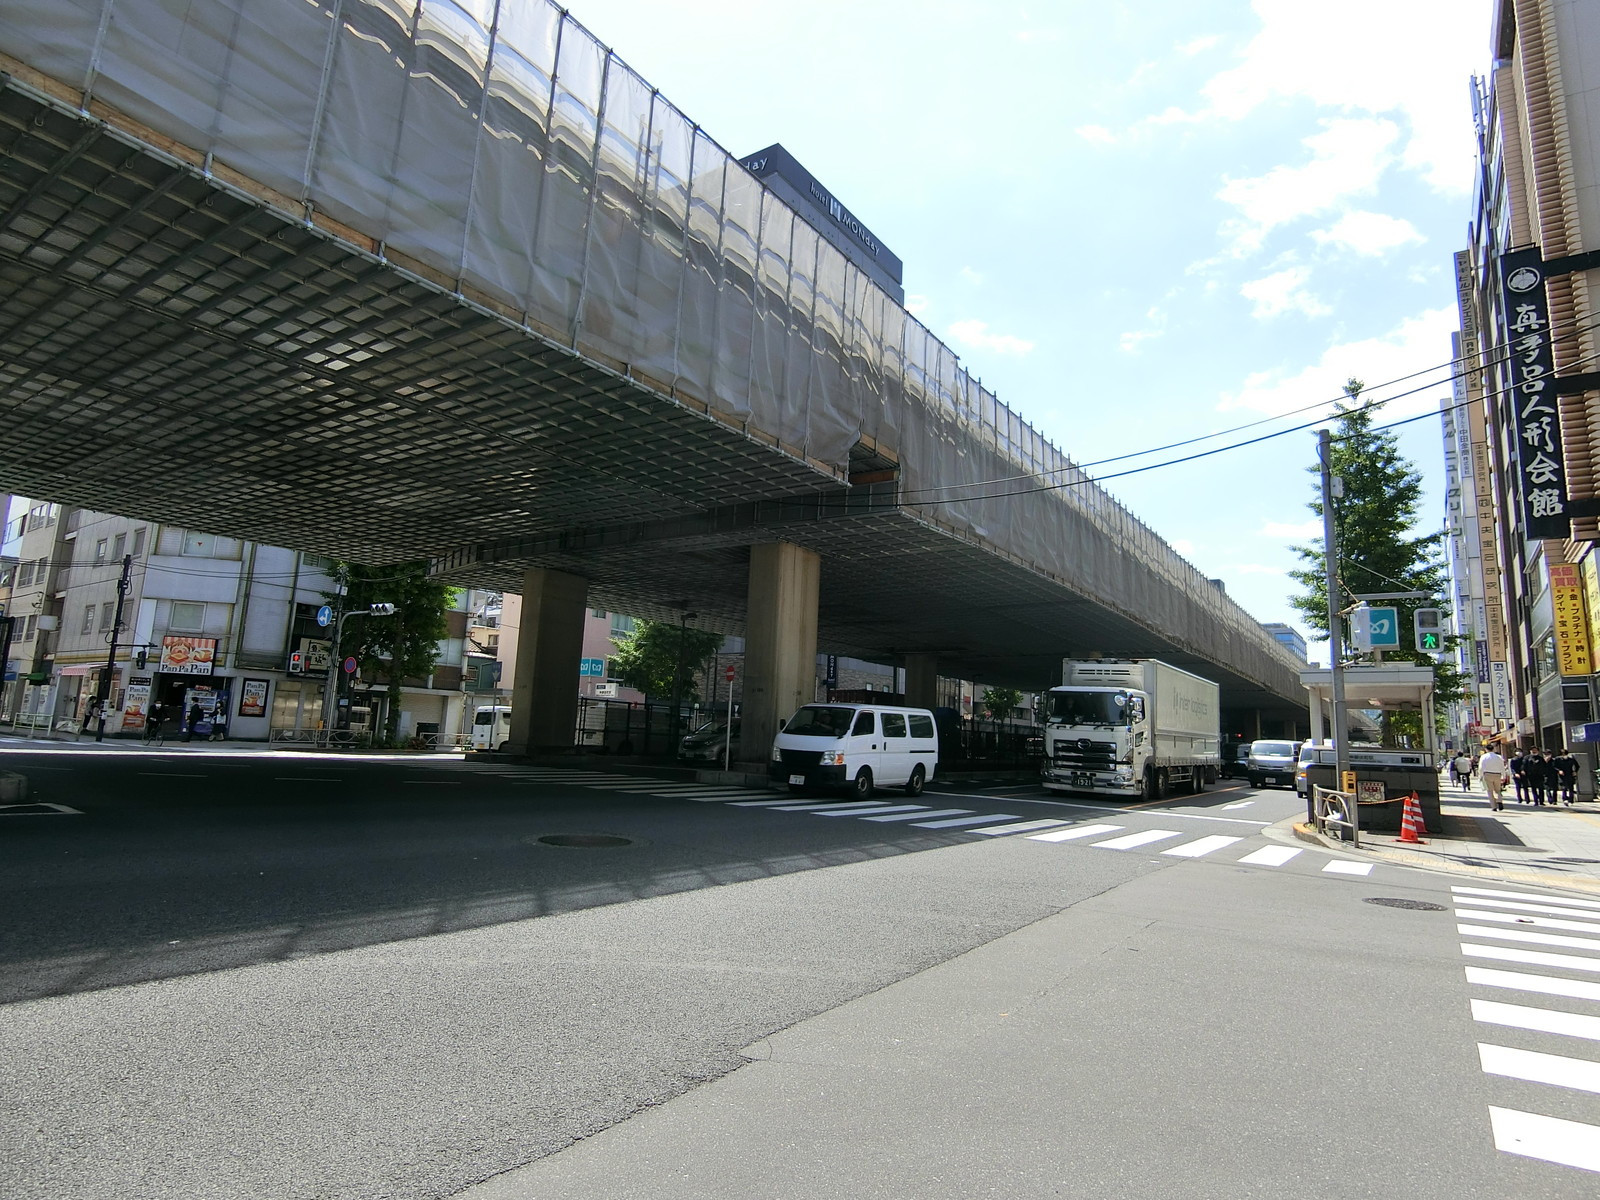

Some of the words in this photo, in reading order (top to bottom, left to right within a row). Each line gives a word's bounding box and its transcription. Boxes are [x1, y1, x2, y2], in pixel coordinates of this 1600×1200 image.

[810, 182, 829, 205] hotel
[842, 216, 880, 256] MONday
[1509, 303, 1563, 518] 真多呂人形会館
[1550, 566, 1573, 577] 高価
[1554, 577, 1578, 587] 買取
[1555, 594, 1566, 613] ダイヤ
[1569, 593, 1578, 601] 金
[1558, 620, 1569, 639] 宝石
[1575, 644, 1586, 665] 時計
[161, 664, 178, 672] Pan
[179, 665, 189, 673] Pa
[190, 663, 210, 674] Pan
